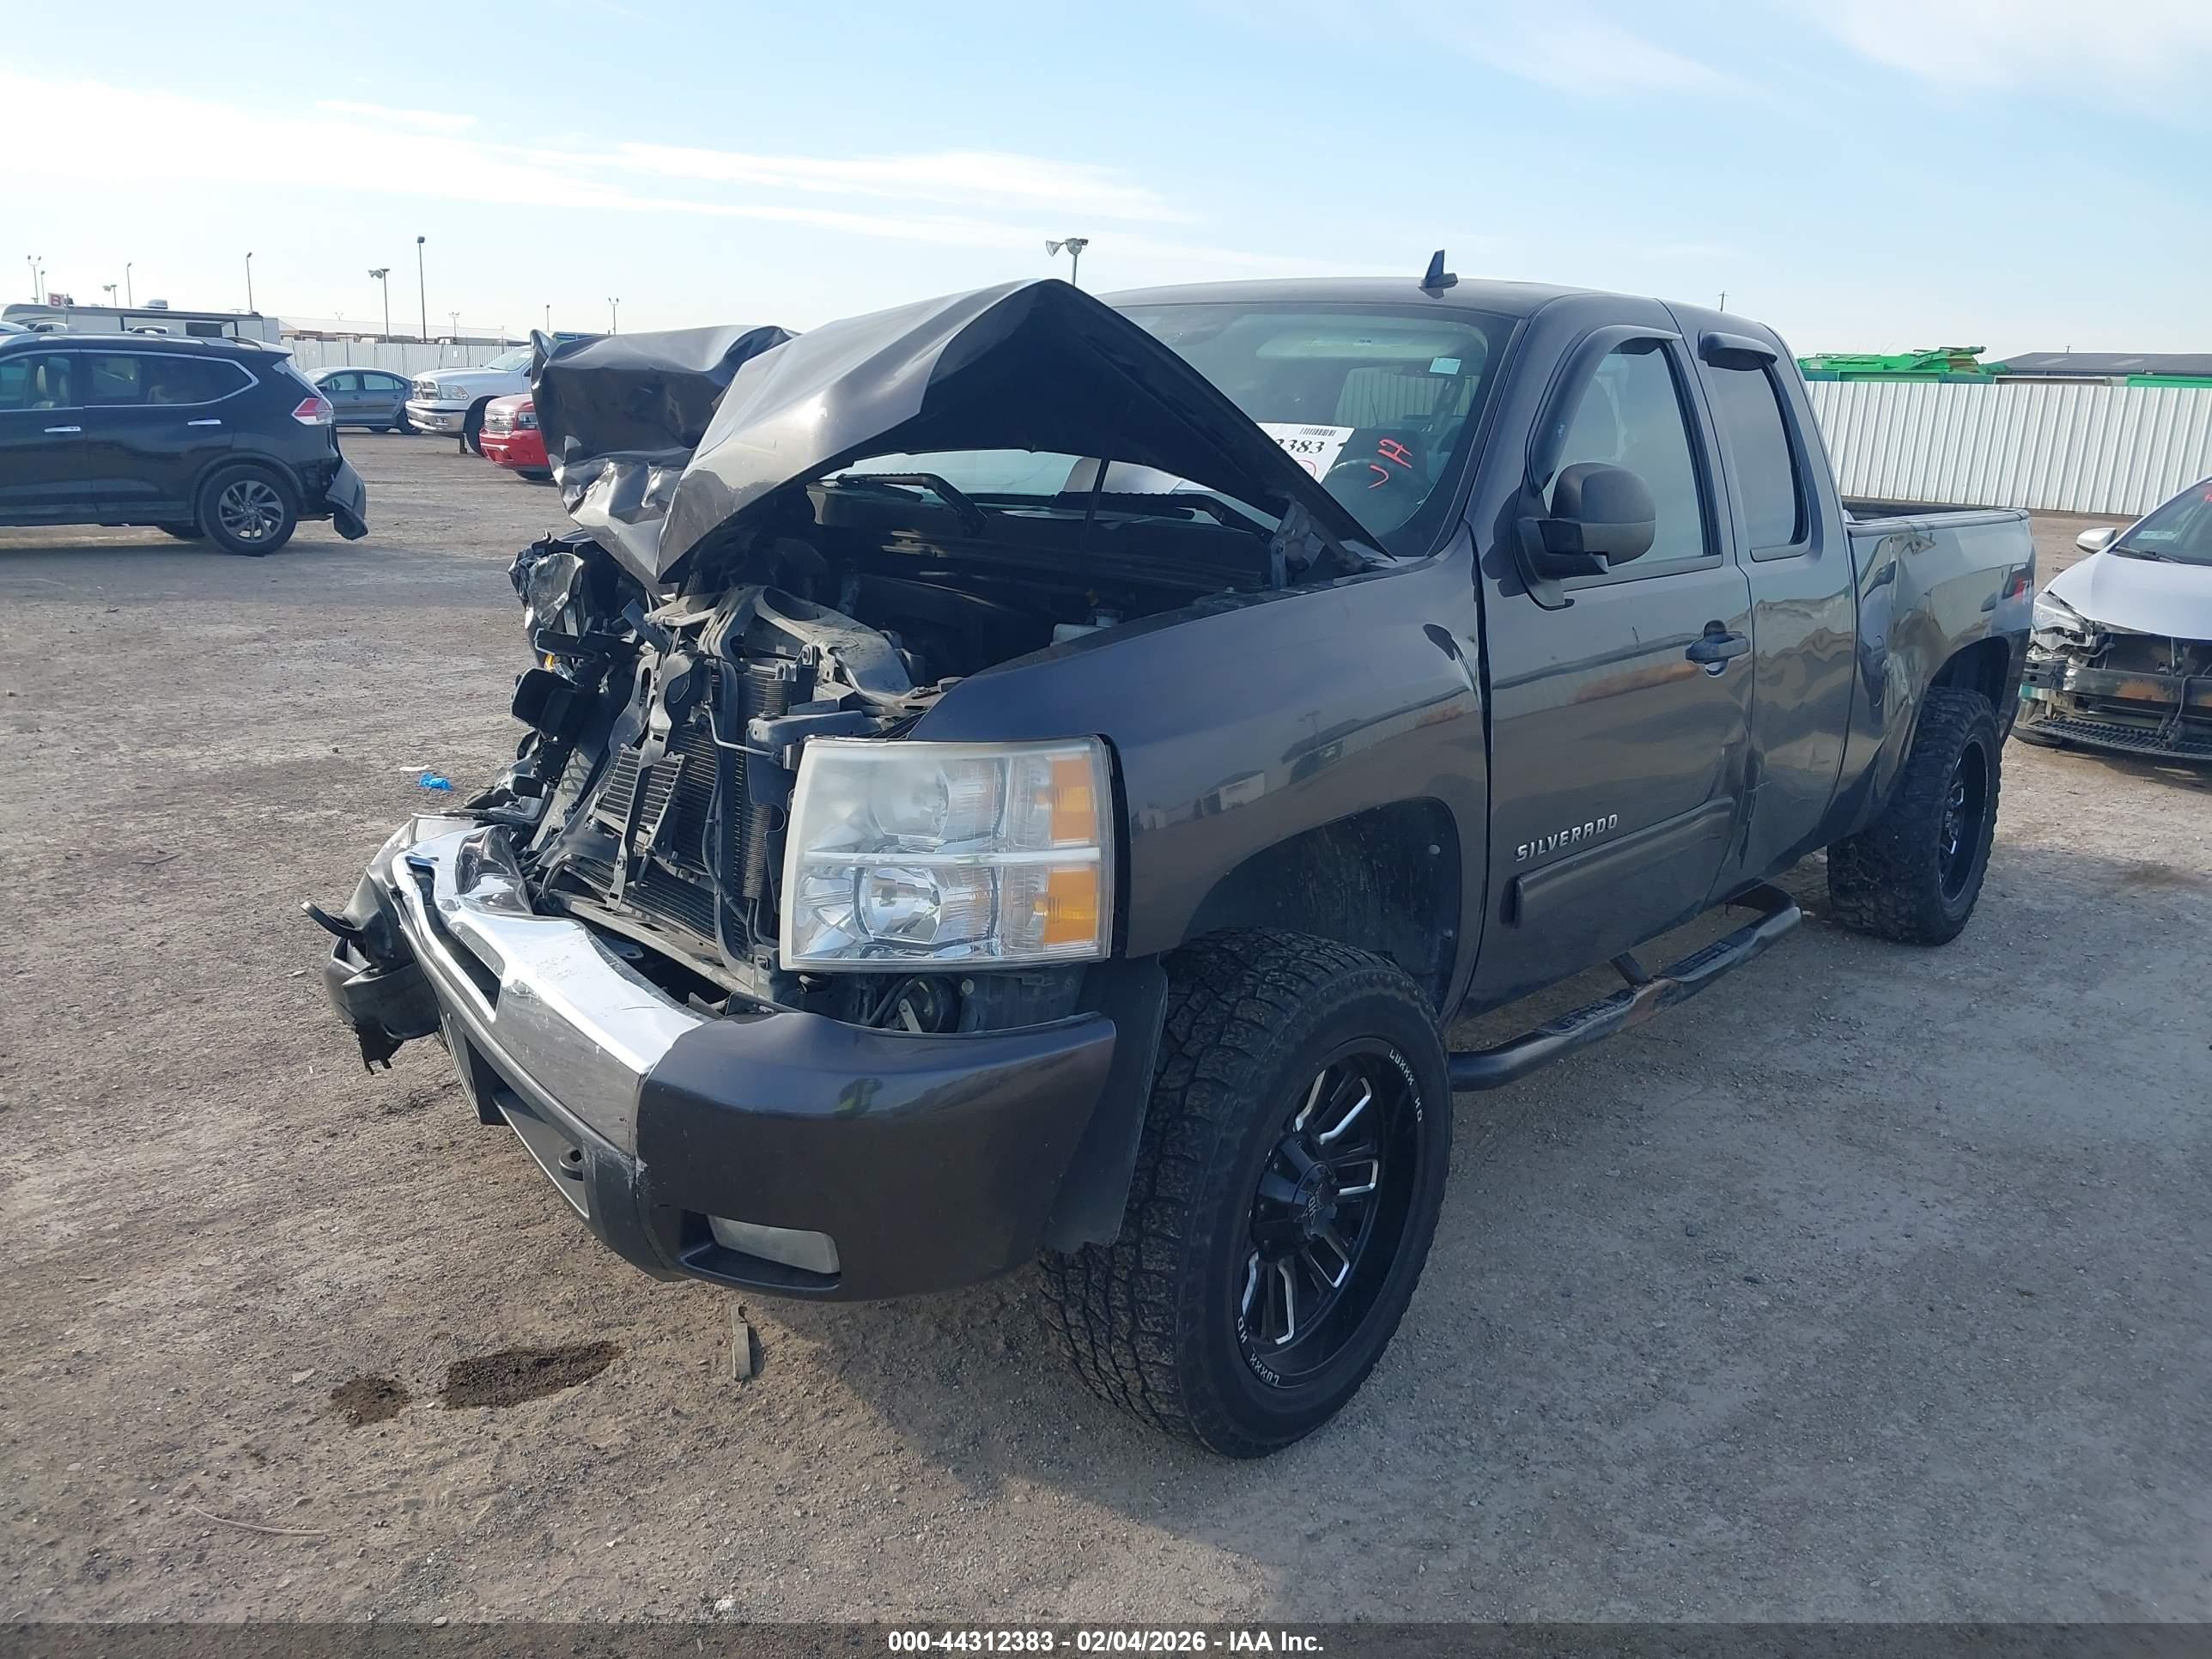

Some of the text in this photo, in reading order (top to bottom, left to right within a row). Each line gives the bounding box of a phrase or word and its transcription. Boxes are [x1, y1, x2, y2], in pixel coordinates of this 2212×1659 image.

[52, 295, 61, 307] B
[1515, 813, 1619, 862] SILVERADO
[1389, 1048, 1423, 1122] LUXXX HD
[1237, 1316, 1280, 1387] LUXXX HD
